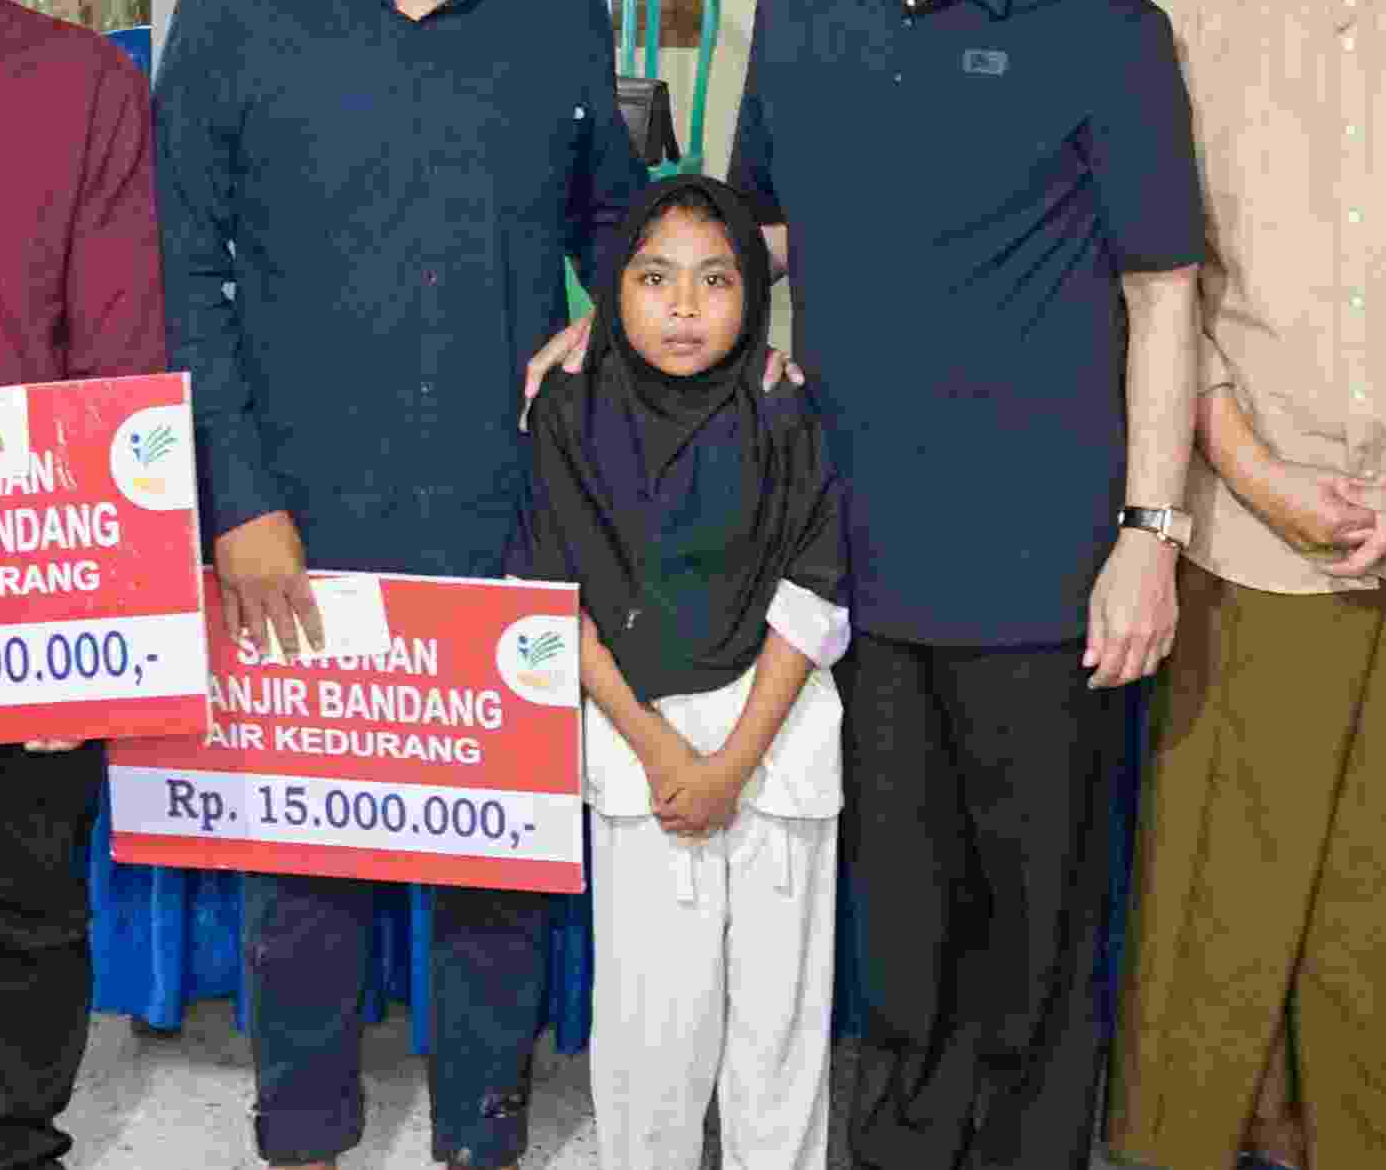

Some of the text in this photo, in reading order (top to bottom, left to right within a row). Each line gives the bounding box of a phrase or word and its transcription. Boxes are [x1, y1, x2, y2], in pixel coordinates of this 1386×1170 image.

[207, 673, 503, 729] ANJIR BANDANG
[204, 722, 484, 764] AIR KEDURANG
[166, 778, 536, 849] Rp. 15.000.000,-
